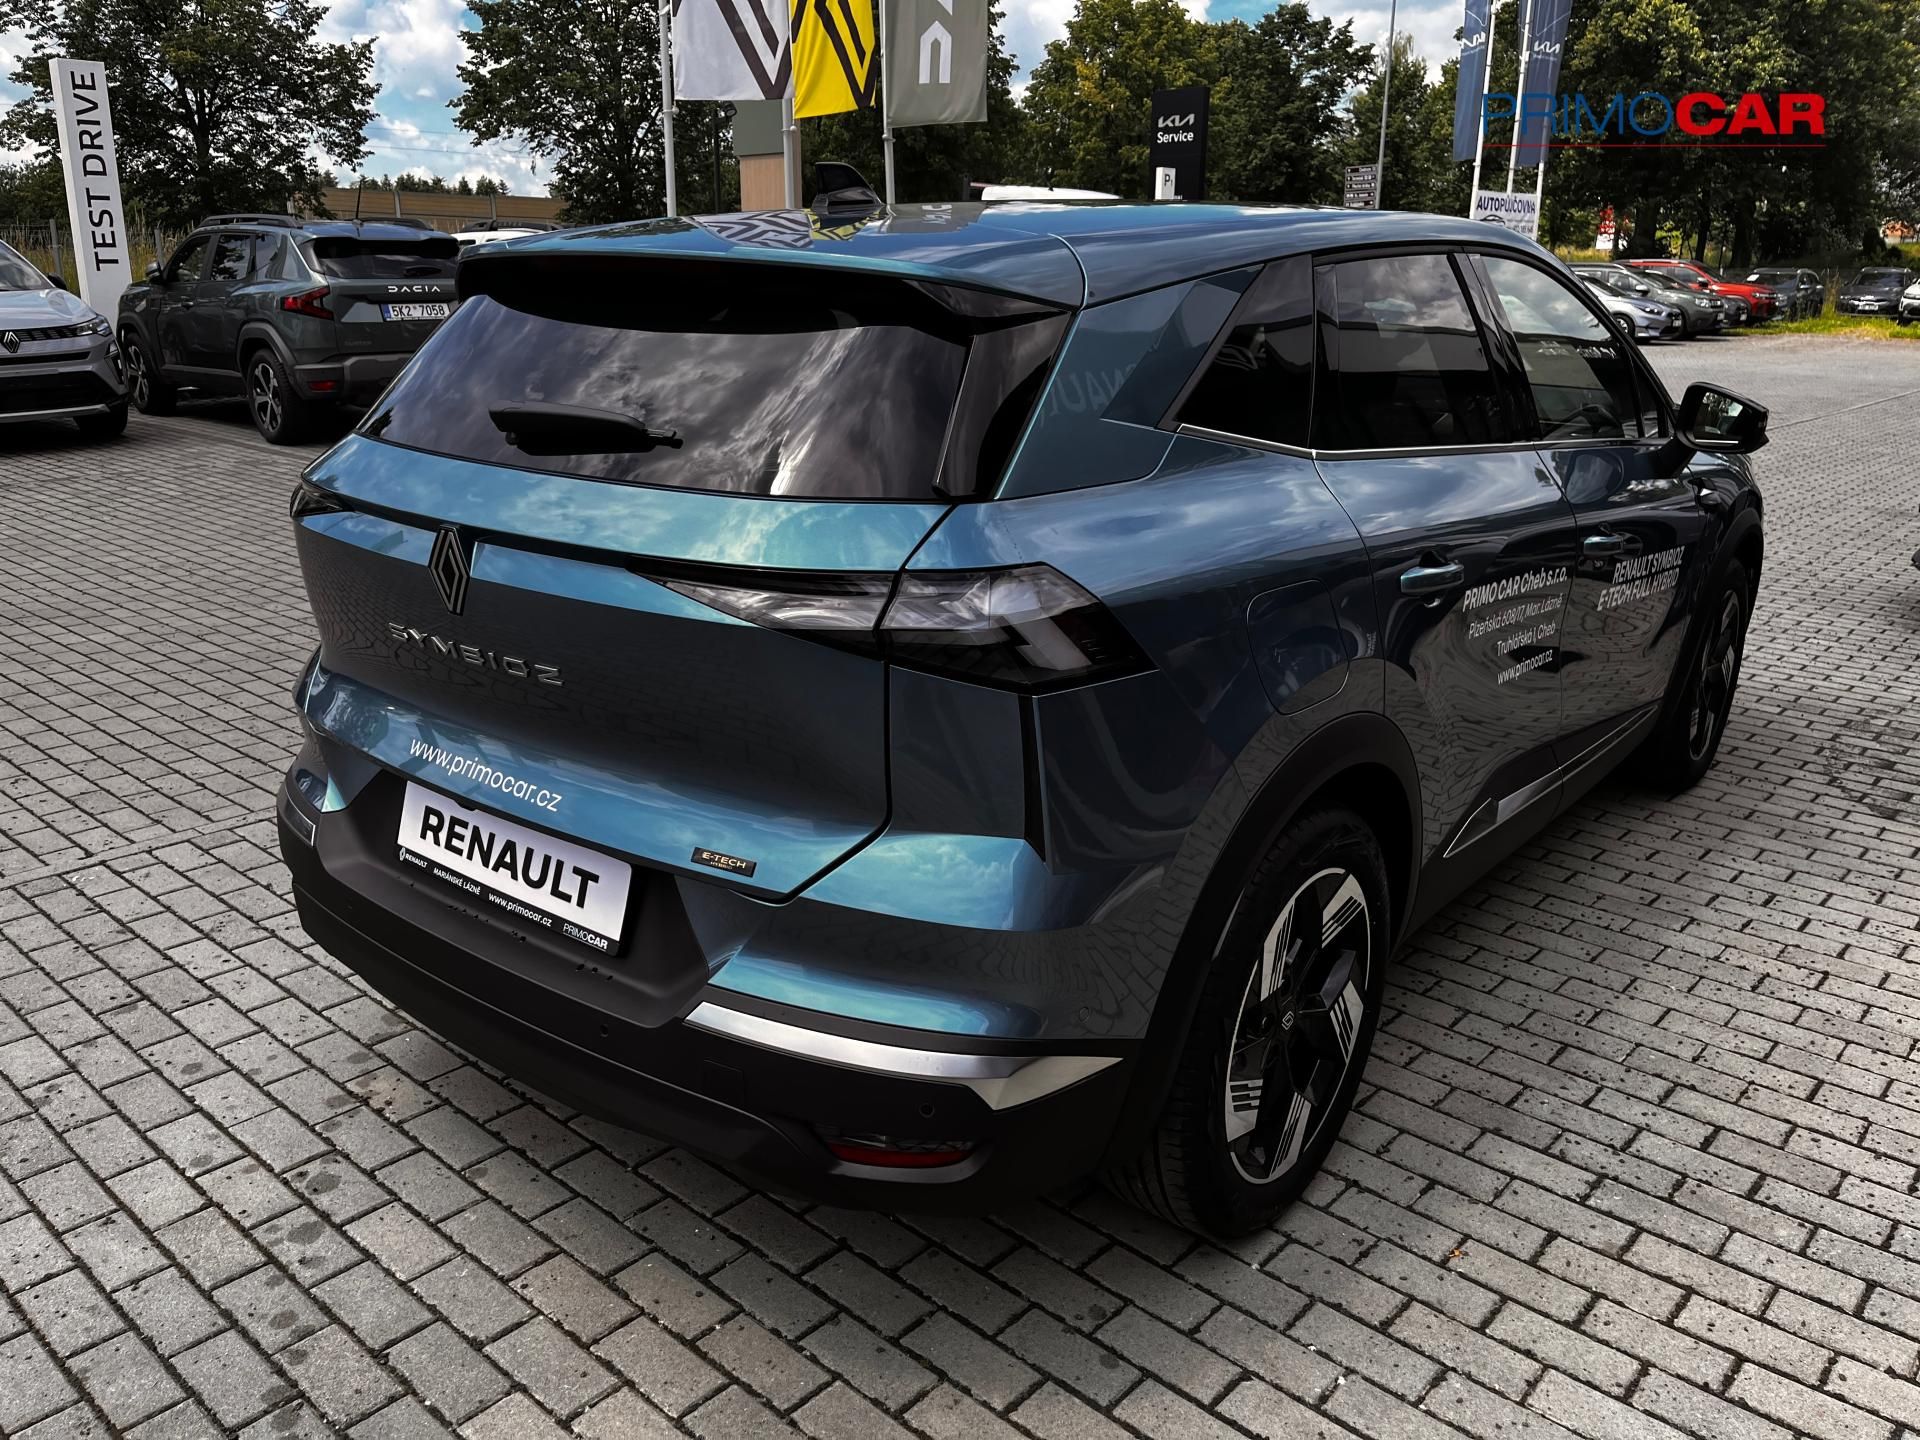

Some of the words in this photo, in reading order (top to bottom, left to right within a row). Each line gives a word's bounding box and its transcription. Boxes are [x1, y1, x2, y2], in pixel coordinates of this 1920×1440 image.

[70, 71, 107, 178] DRIVE
[1157, 130, 1194, 144] Service
[1158, 113, 1195, 128] KIA
[85, 187, 119, 272] TEST
[387, 285, 441, 293] DACIA
[419, 304, 445, 317] 7058
[1612, 553, 1654, 585] RENAULT
[1651, 545, 1685, 573] SYMBIOZ
[1462, 582, 1498, 613] PRIMO
[1498, 575, 1521, 600] CAR
[1520, 567, 1546, 593] Cheb
[1546, 566, 1567, 586] s.r.o.
[1596, 581, 1633, 612] E-TECH
[1630, 576, 1652, 601] FULL
[1650, 567, 1680, 595] HYBRID
[1468, 613, 1501, 640] Plzeňská
[1525, 601, 1540, 618] Mar.
[1537, 619, 1556, 640] Cheb
[388, 622, 566, 687] SYMBIOZ
[1497, 649, 1553, 685] www.primocar.cz
[410, 739, 562, 812] www.primocar.cz
[405, 853, 428, 869] RENAULT
[419, 805, 600, 909] RENAULT
[702, 851, 747, 869] E-TECH
[433, 867, 463, 888] MARIÁNSKÉ
[463, 879, 481, 896] LÁZNĚ
[488, 892, 552, 927] www.primocar.cz
[563, 923, 608, 950] PRIMOCAR
